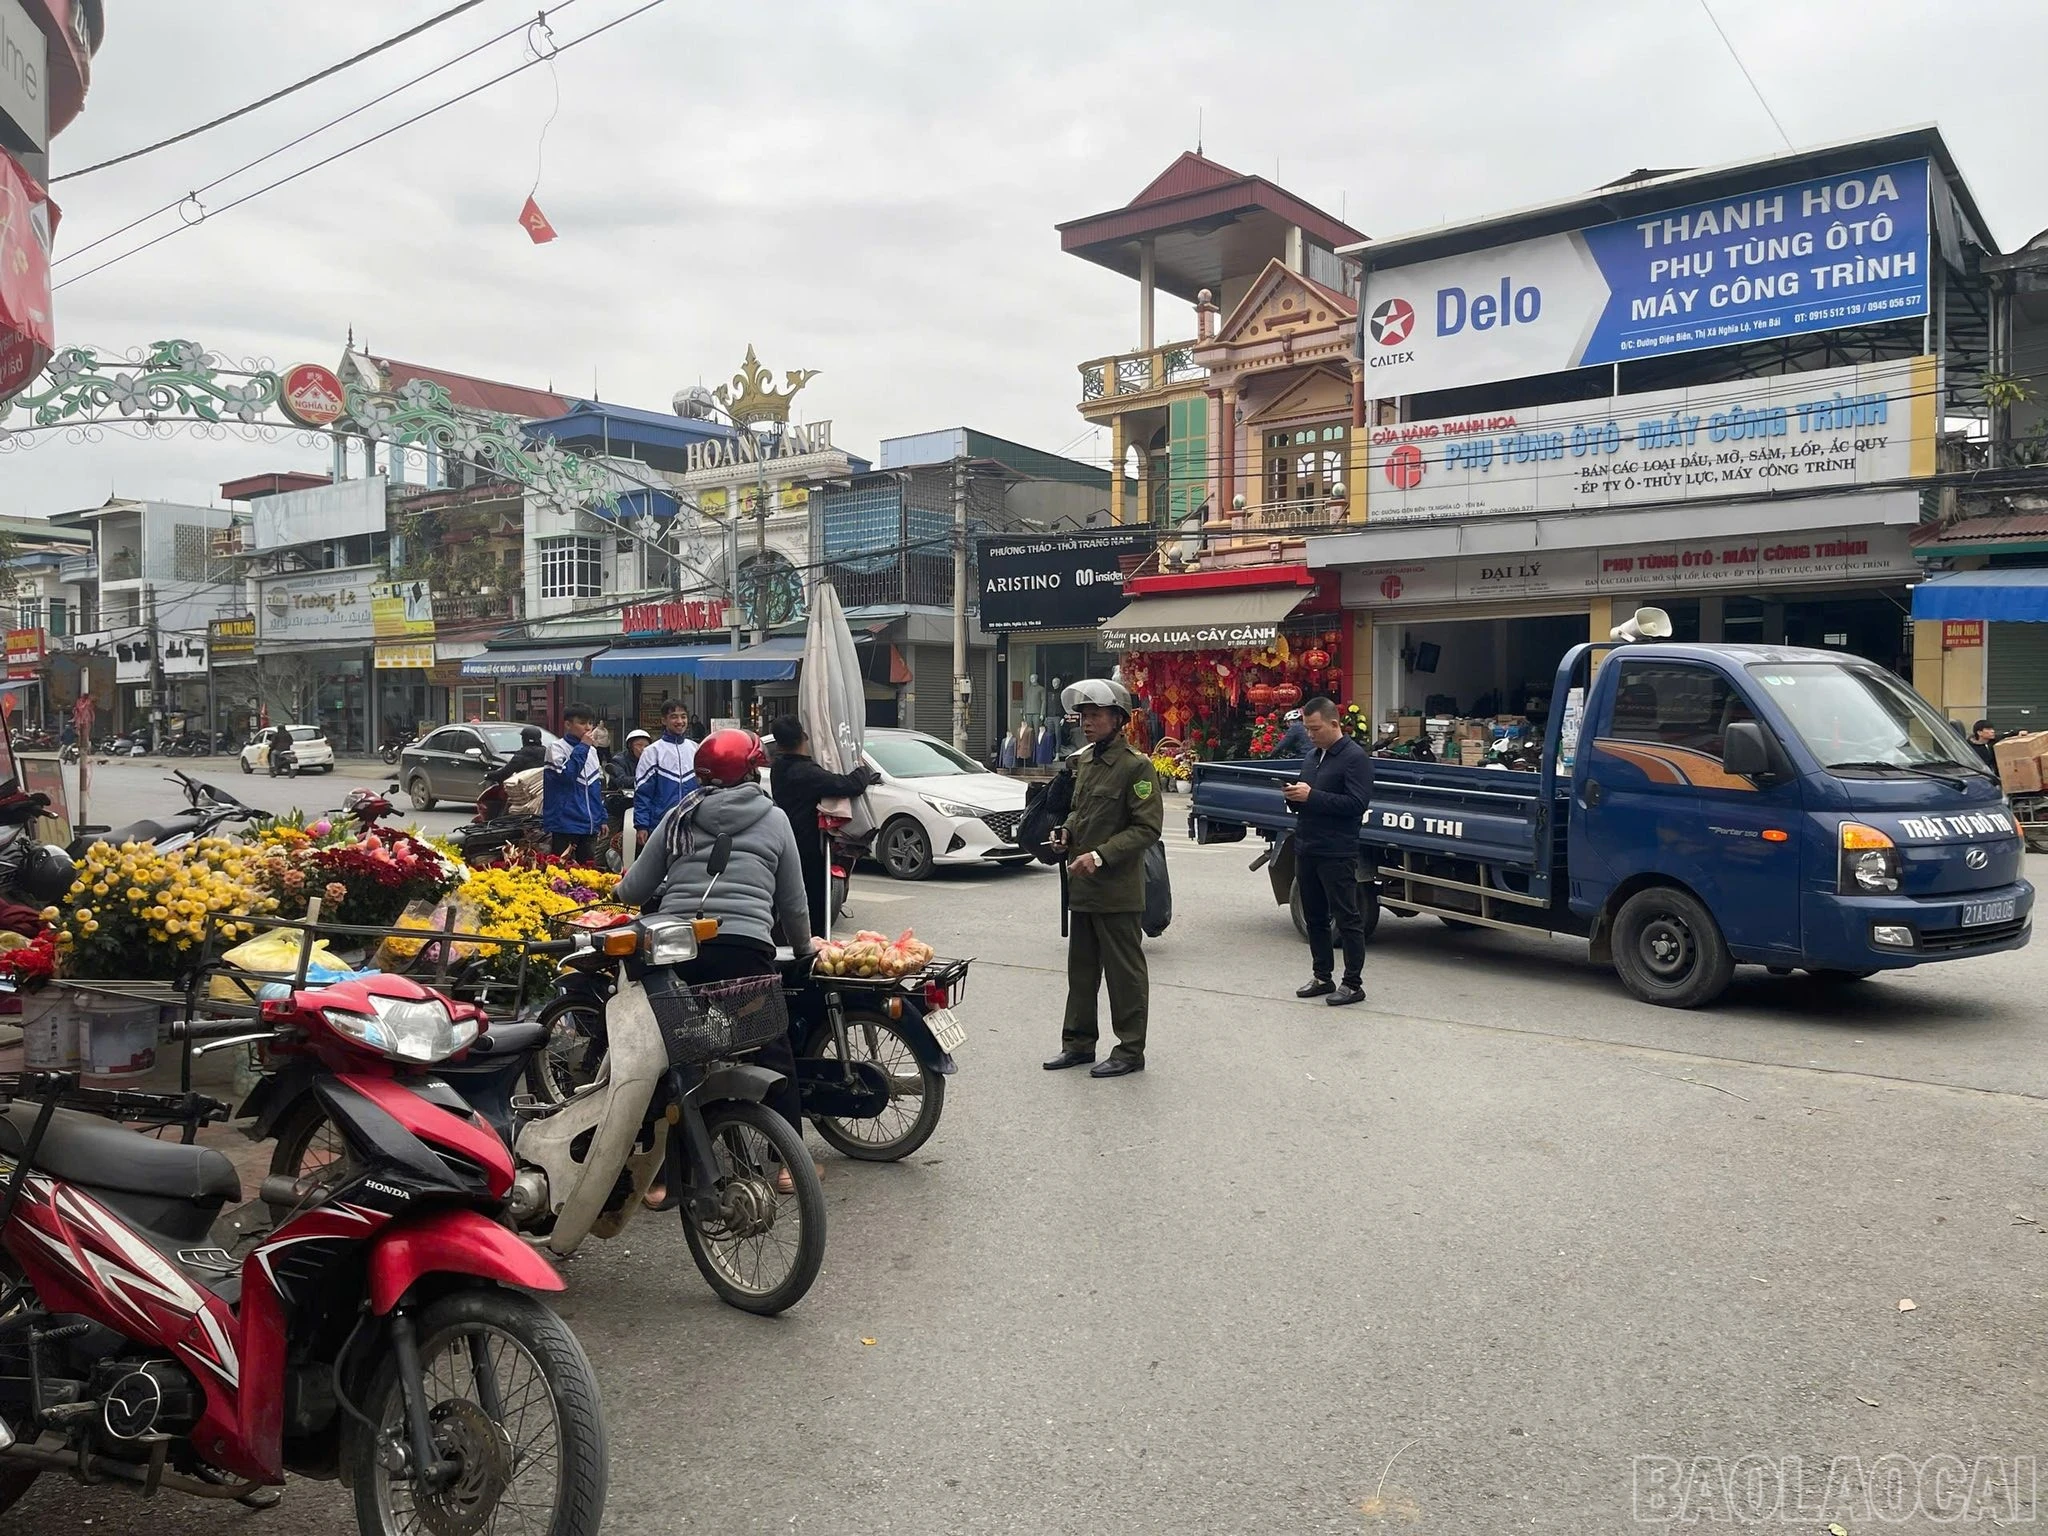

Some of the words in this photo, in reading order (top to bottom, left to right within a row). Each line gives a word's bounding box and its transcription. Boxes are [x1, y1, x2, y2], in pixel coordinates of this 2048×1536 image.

[1636, 195, 1784, 250] THANH
[1801, 173, 1900, 218] HOA
[1650, 249, 1714, 284] PHỤ
[1723, 236, 1814, 270] TÙNG
[1825, 211, 1894, 251] ÔTÔ
[1630, 288, 1700, 322] MÁY
[1708, 272, 1800, 308] CÔNG
[1810, 251, 1917, 292] TRÌNH
[1436, 276, 1542, 338] Delo
[1809, 309, 1829, 321] 0915
[1829, 307, 1845, 319] 512
[1846, 304, 1861, 316] 139
[1867, 301, 1888, 312] 0945
[1905, 294, 1922, 306] 577
[1369, 351, 1415, 369] CALTEX
[777, 419, 833, 458] ANH
[1442, 417, 1484, 437] THANH
[1486, 414, 1518, 431] HOA
[1444, 438, 1494, 473] PHỤ
[1499, 431, 1566, 466] TÙNG
[1570, 420, 1621, 457] ÔTÔ
[1637, 409, 1701, 451] MÁY
[1707, 404, 1789, 443] CÔNG
[1795, 390, 1889, 434] TRÌNH
[1581, 464, 1609, 478] BÁN
[1612, 460, 1639, 475] CÁC
[1642, 457, 1677, 473] LOẠI
[1790, 439, 1825, 458] LỐP,
[1829, 436, 1850, 454] ẮC
[1853, 436, 1889, 451] QUY
[1580, 480, 1599, 494] ÉP
[1603, 480, 1621, 492] TY
[1686, 470, 1718, 487] LỰC,
[1722, 466, 1753, 482] MÁY
[1758, 463, 1799, 478] CÔNG
[1805, 457, 1856, 474] TRÌNH
[989, 545, 1026, 557] PHƯƠNG
[1027, 540, 1052, 554] THẢO
[1079, 537, 1110, 549] TRANG
[1602, 557, 1634, 573] PHỤ
[1637, 553, 1679, 570] TÙNG
[1681, 550, 1713, 567] ÔTÔ
[1722, 546, 1759, 564] MÁY
[1763, 543, 1810, 562] CÔNG
[1814, 540, 1869, 559] TRÌNH
[986, 573, 1061, 593] ARISTINO
[1480, 566, 1513, 582] ĐẠI
[1518, 561, 1542, 578] LÝ
[1129, 632, 1161, 644] HOA
[1163, 631, 1190, 646] LỤA
[1196, 627, 1228, 641] CÂY
[1230, 625, 1276, 640] CẢNH
[1382, 812, 1415, 830] ĐÔ
[1422, 817, 1463, 839] THỊ
[1898, 815, 1950, 841] TRẬT
[1945, 814, 1974, 838] TỰ
[1967, 812, 1996, 834] ĐÔ
[1986, 812, 2015, 835] THỊ
[364, 1179, 411, 1200] HONDA
